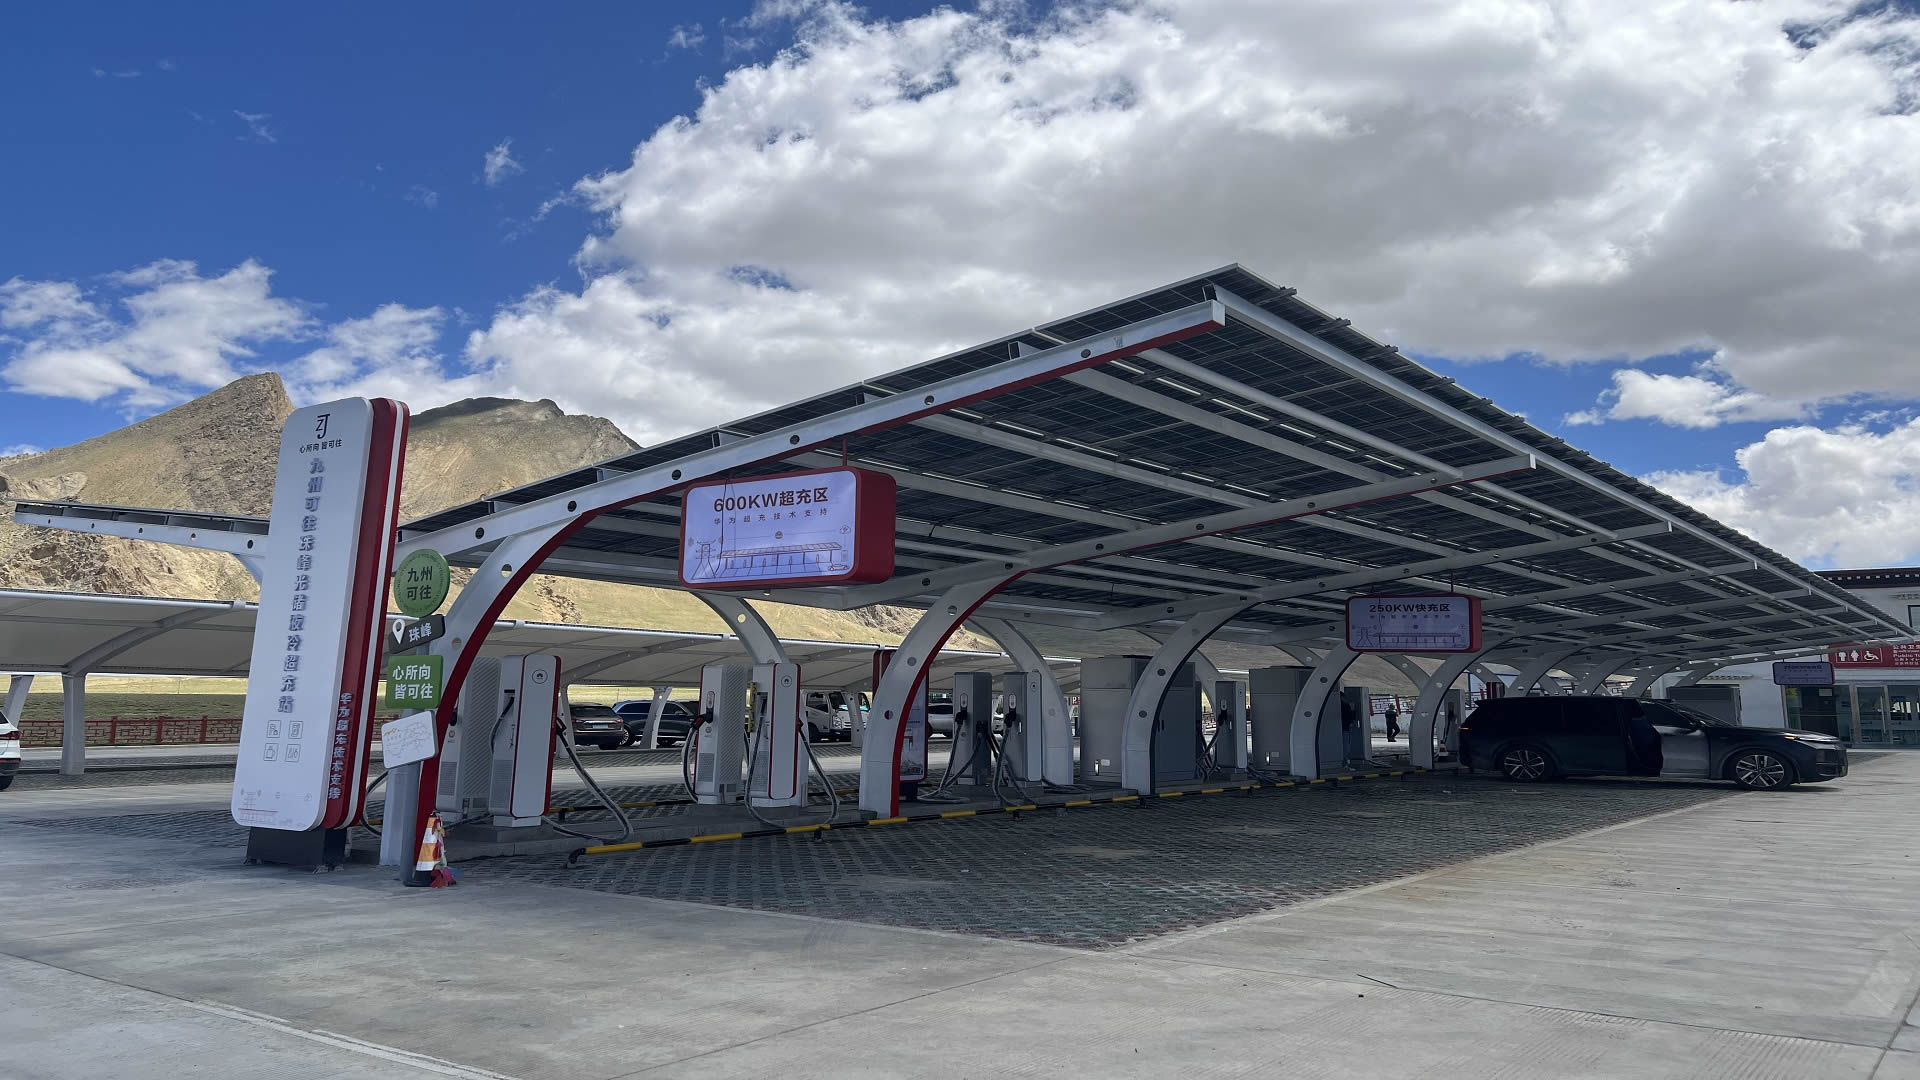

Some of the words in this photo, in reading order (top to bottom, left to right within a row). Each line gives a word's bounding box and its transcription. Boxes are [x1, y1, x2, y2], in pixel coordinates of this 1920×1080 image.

[299, 443, 320, 454] 心所向
[321, 439, 342, 450] 皆可往
[713, 487, 829, 512] 600KW超充区
[407, 566, 433, 583] 九州
[407, 584, 432, 601] 可往
[1369, 603, 1451, 613] 250KW快充区
[408, 622, 432, 642] 珠峰
[392, 663, 431, 681] 心所向
[394, 683, 433, 700] 皆可往
